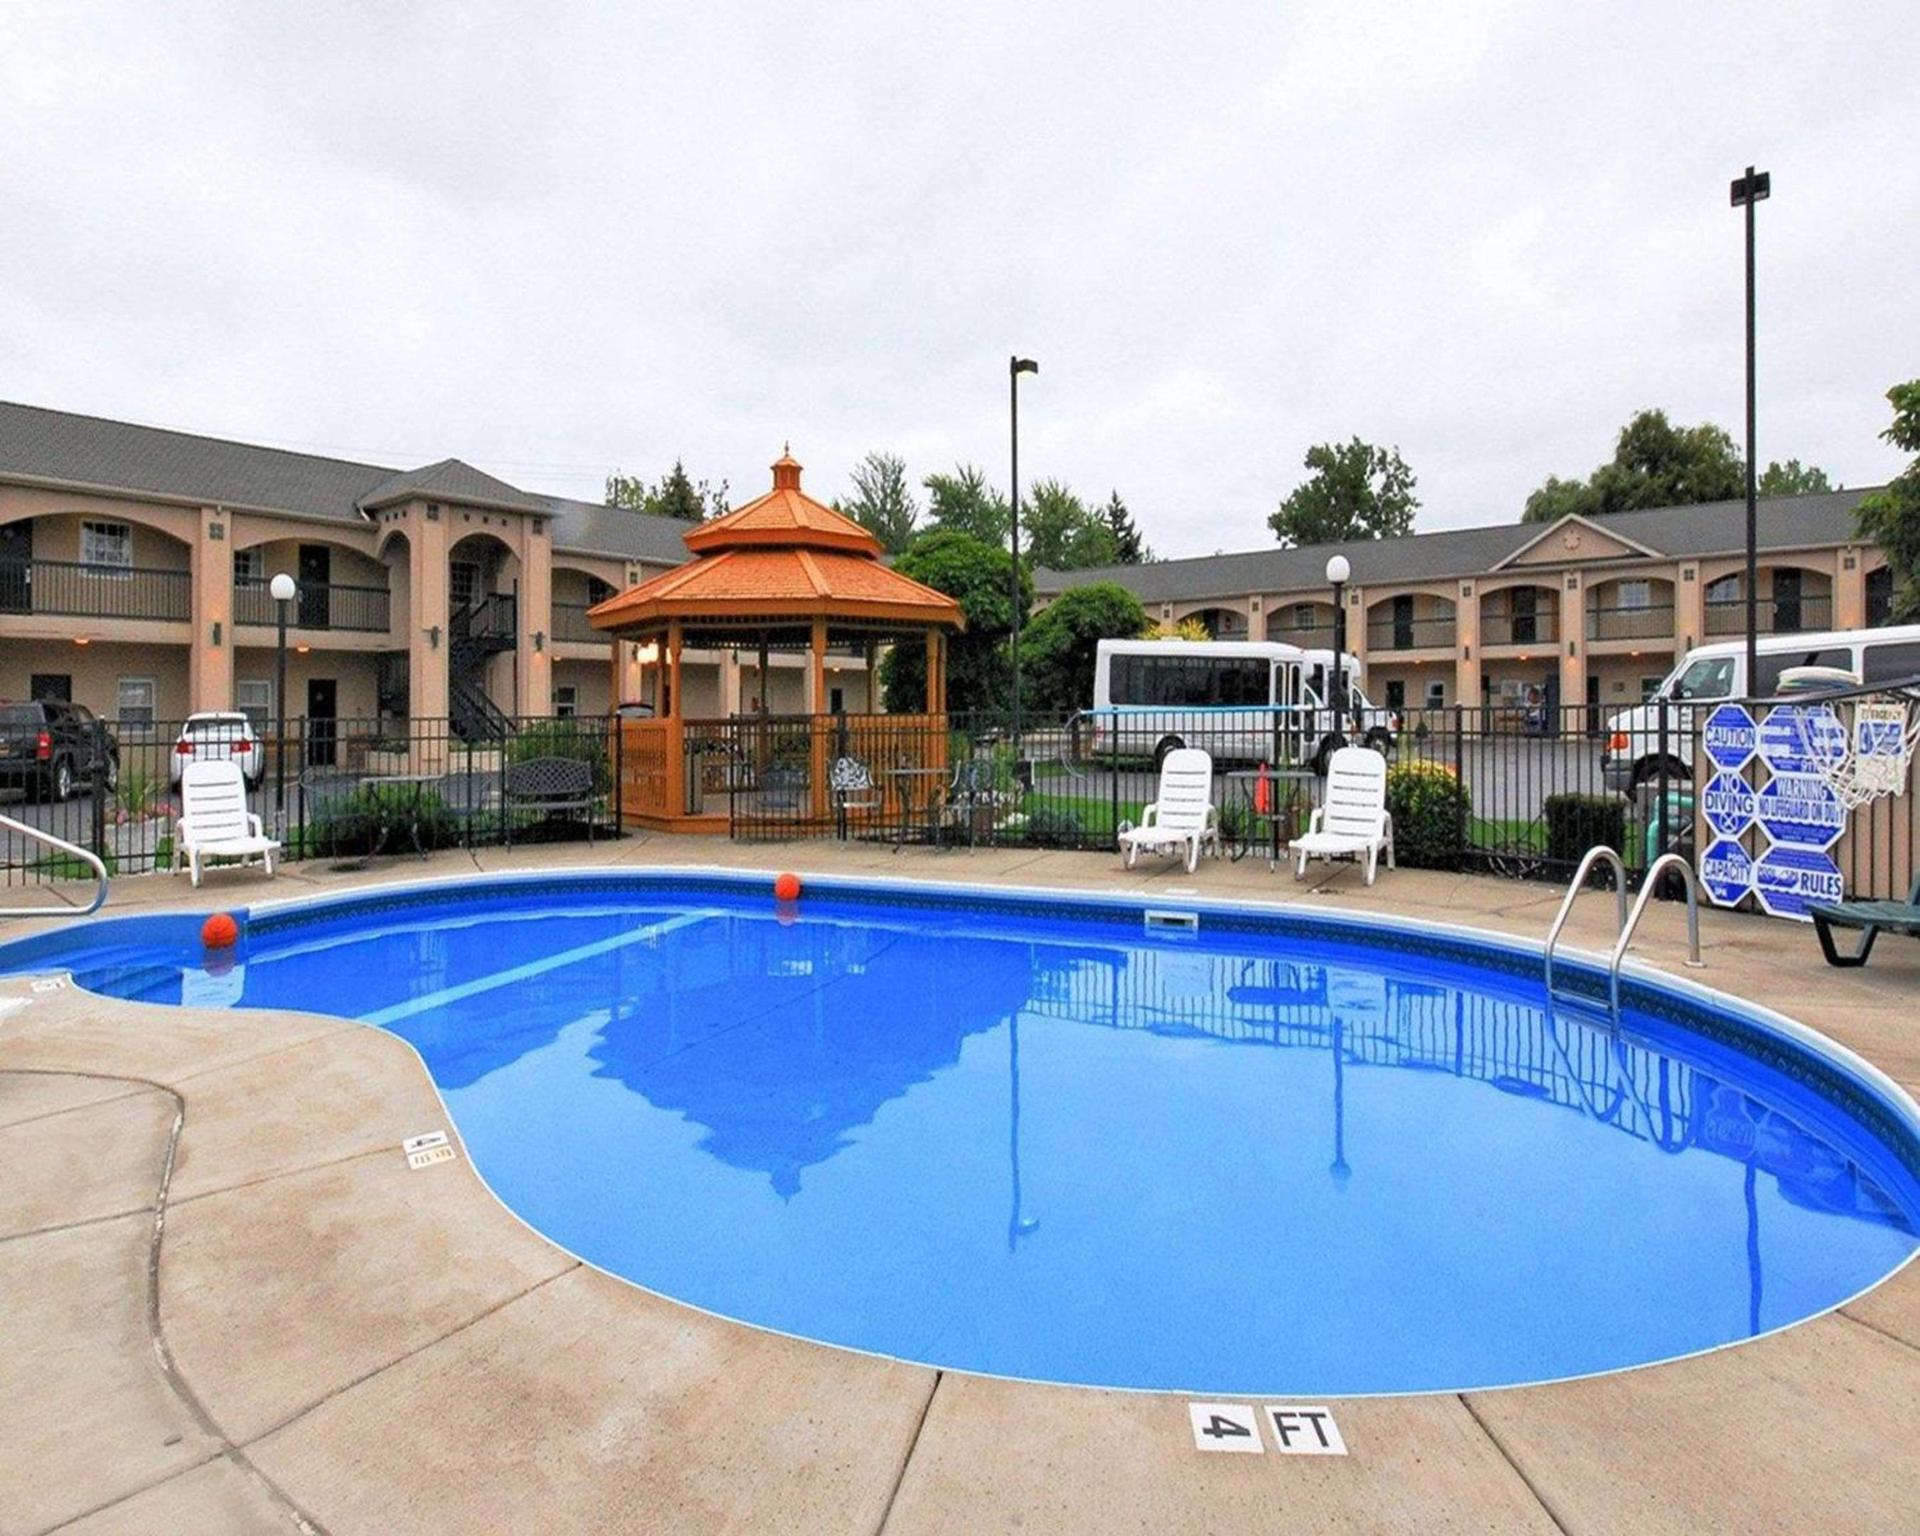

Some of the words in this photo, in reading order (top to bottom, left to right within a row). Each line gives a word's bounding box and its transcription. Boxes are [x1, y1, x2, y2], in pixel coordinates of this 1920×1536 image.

[1705, 727, 1756, 746] CAUTION
[1720, 772, 1740, 794] NO
[1776, 778, 1827, 800] WARNING
[1705, 792, 1754, 814] DIVING
[1759, 798, 1769, 816] NO
[1770, 799, 1810, 820] LIFEGUARD
[1811, 802, 1822, 822] ON
[1825, 803, 1845, 824] DUTY
[1703, 859, 1751, 882] CAPACITY
[1800, 872, 1842, 897] RULES
[1202, 1414, 1251, 1439] 4
[1272, 1411, 1330, 1447] FT
